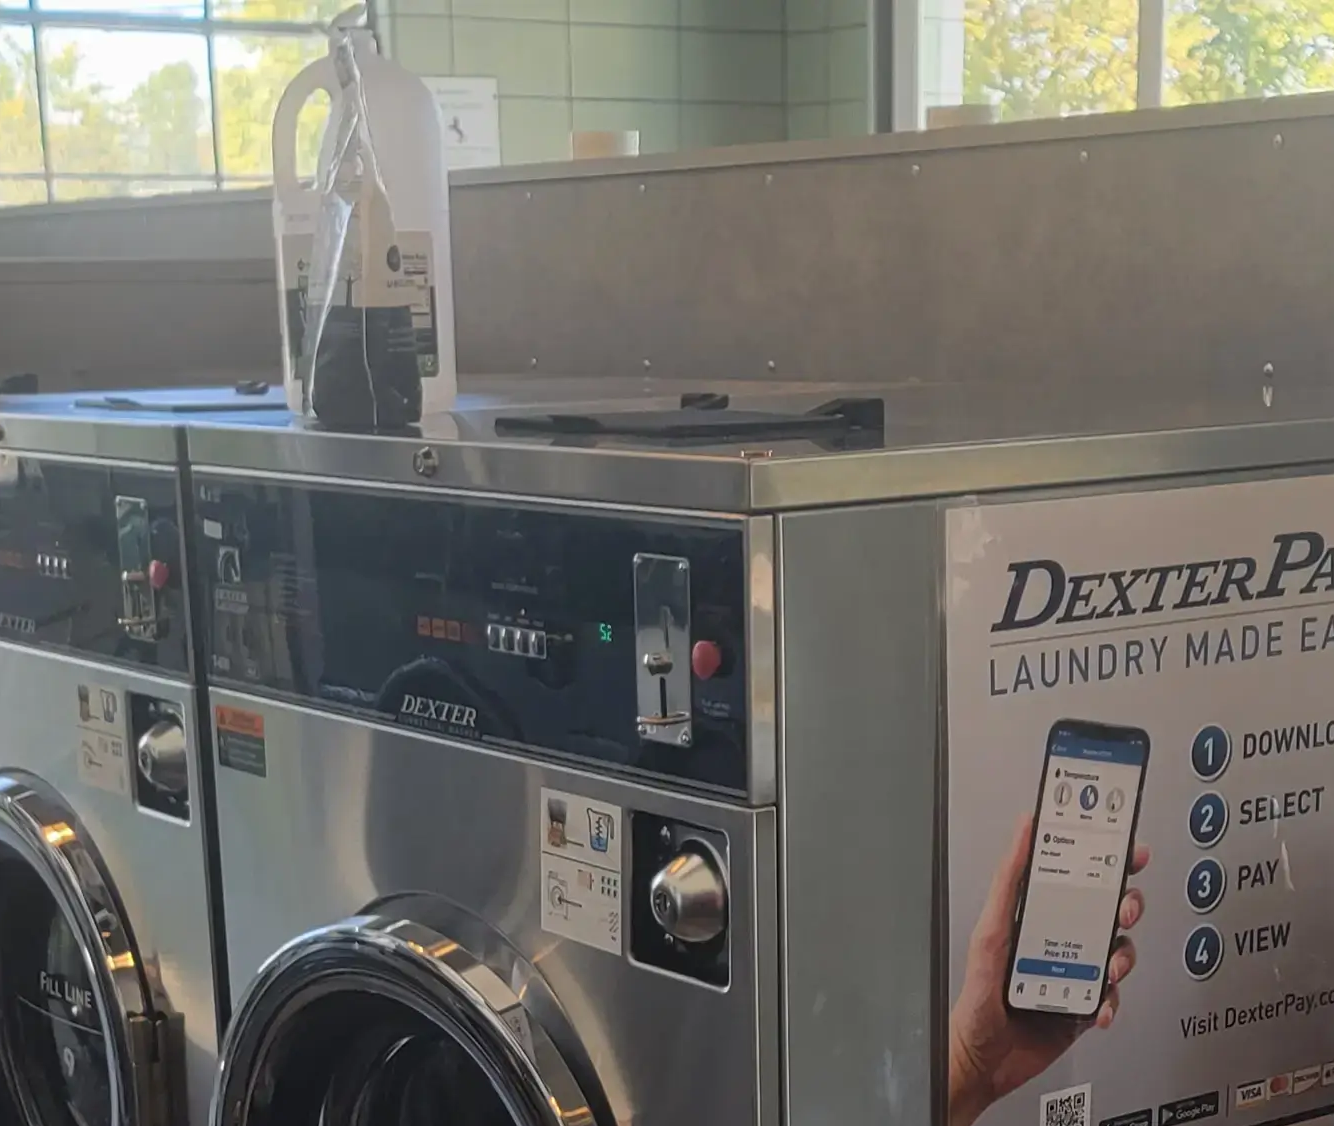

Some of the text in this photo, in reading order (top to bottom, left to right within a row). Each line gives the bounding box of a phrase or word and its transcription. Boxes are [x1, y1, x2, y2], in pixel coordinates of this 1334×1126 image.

[988, 635, 1168, 697] LAUNDRY
[1185, 621, 1284, 669] MADE
[400, 693, 478, 728] DEXTER
[1203, 736, 1214, 767] 1
[1199, 786, 1325, 834] 2 SELECT
[1197, 858, 1280, 898] 3 PAY
[1194, 921, 1291, 965] 4 VIEW
[63, 980, 93, 1009] LINE
[1180, 1012, 1219, 1039] Visit
[1240, 1086, 1262, 1101] VISA
[1175, 1107, 1201, 1120] Google
